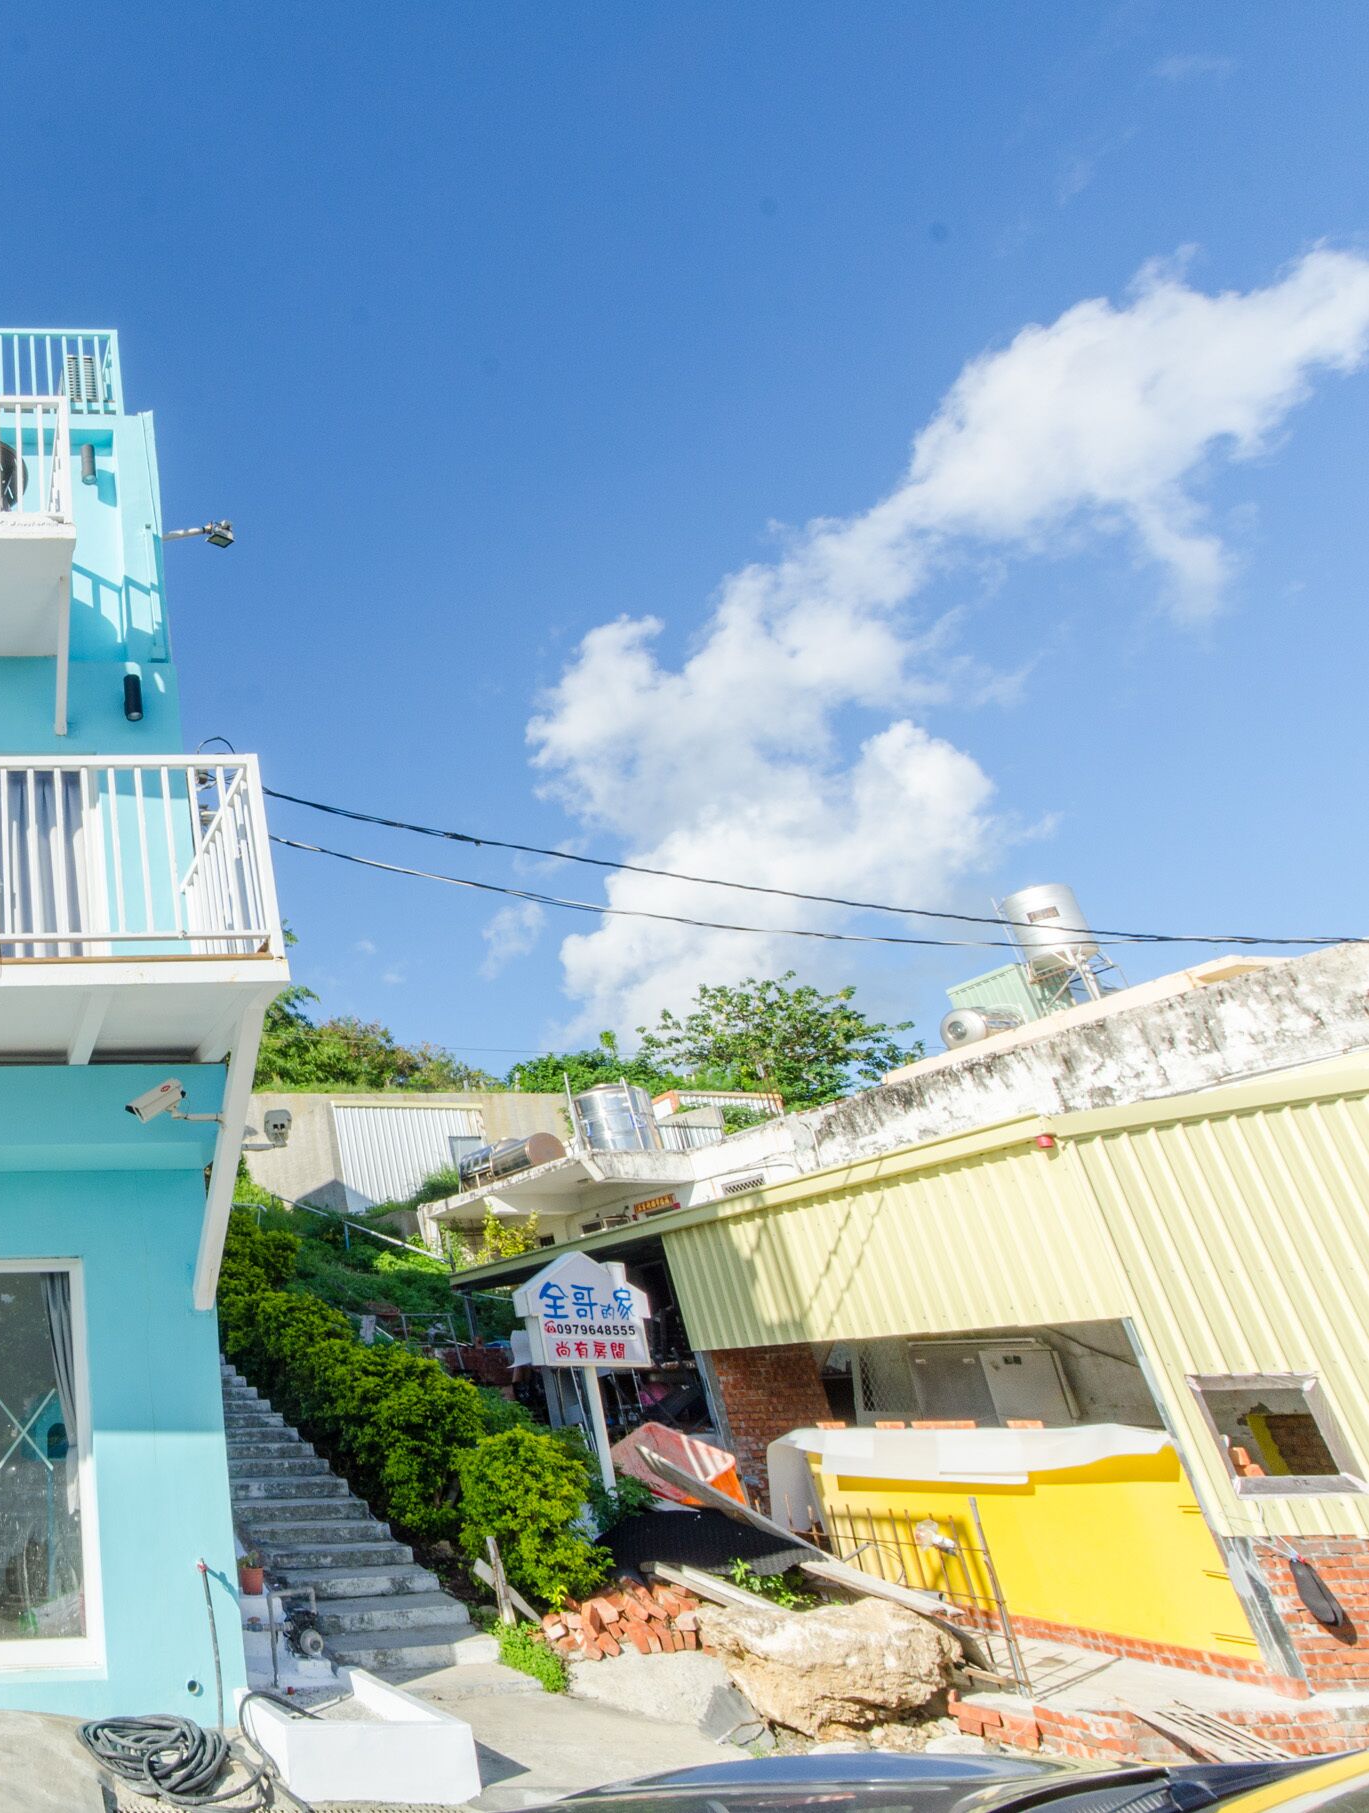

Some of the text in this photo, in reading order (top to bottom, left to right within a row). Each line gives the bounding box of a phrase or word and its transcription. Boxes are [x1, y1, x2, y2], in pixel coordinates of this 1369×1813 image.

[539, 1281, 634, 1320] 全哥的家
[557, 1323, 636, 1336] 0979648555
[555, 1340, 626, 1360] 尚有房間
